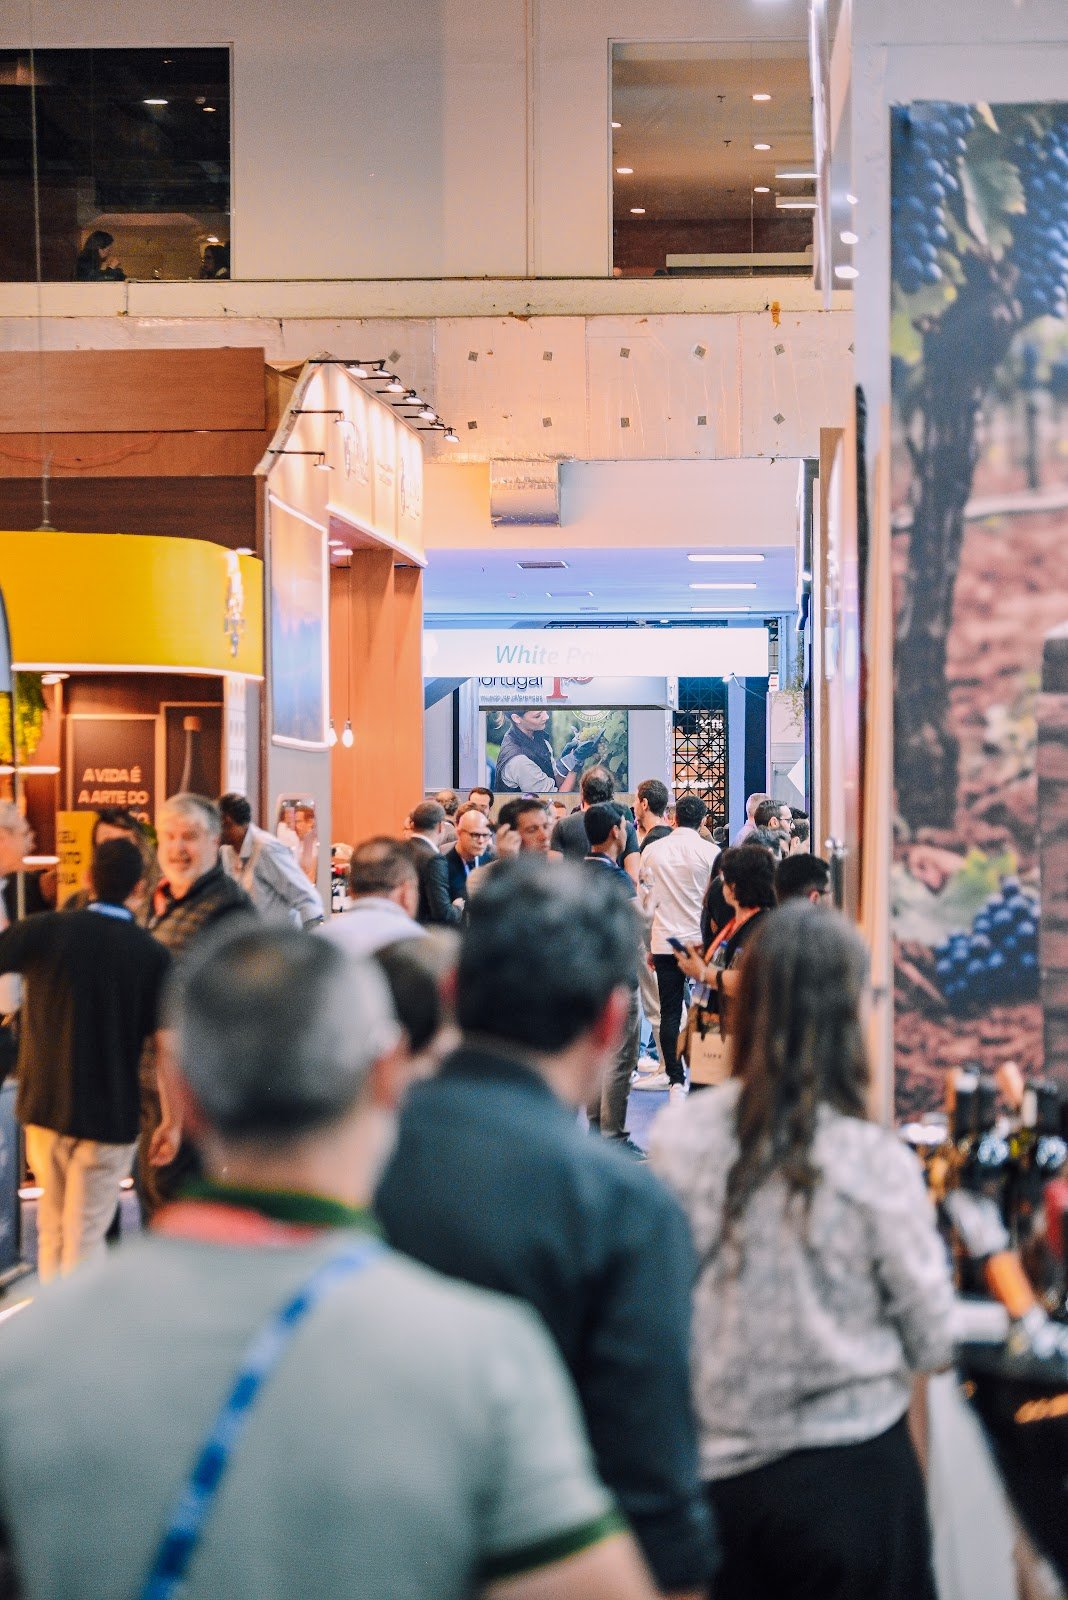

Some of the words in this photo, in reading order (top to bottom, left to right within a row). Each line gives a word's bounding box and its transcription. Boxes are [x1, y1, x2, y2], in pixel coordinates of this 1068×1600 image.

[495, 645, 559, 665] White
[478, 677, 543, 690] ortugal
[82, 768, 95, 782] A
[95, 768, 129, 783] VIDA
[130, 766, 142, 783] É
[77, 789, 90, 804] A
[90, 789, 127, 804] ARTE
[127, 790, 150, 804] DO
